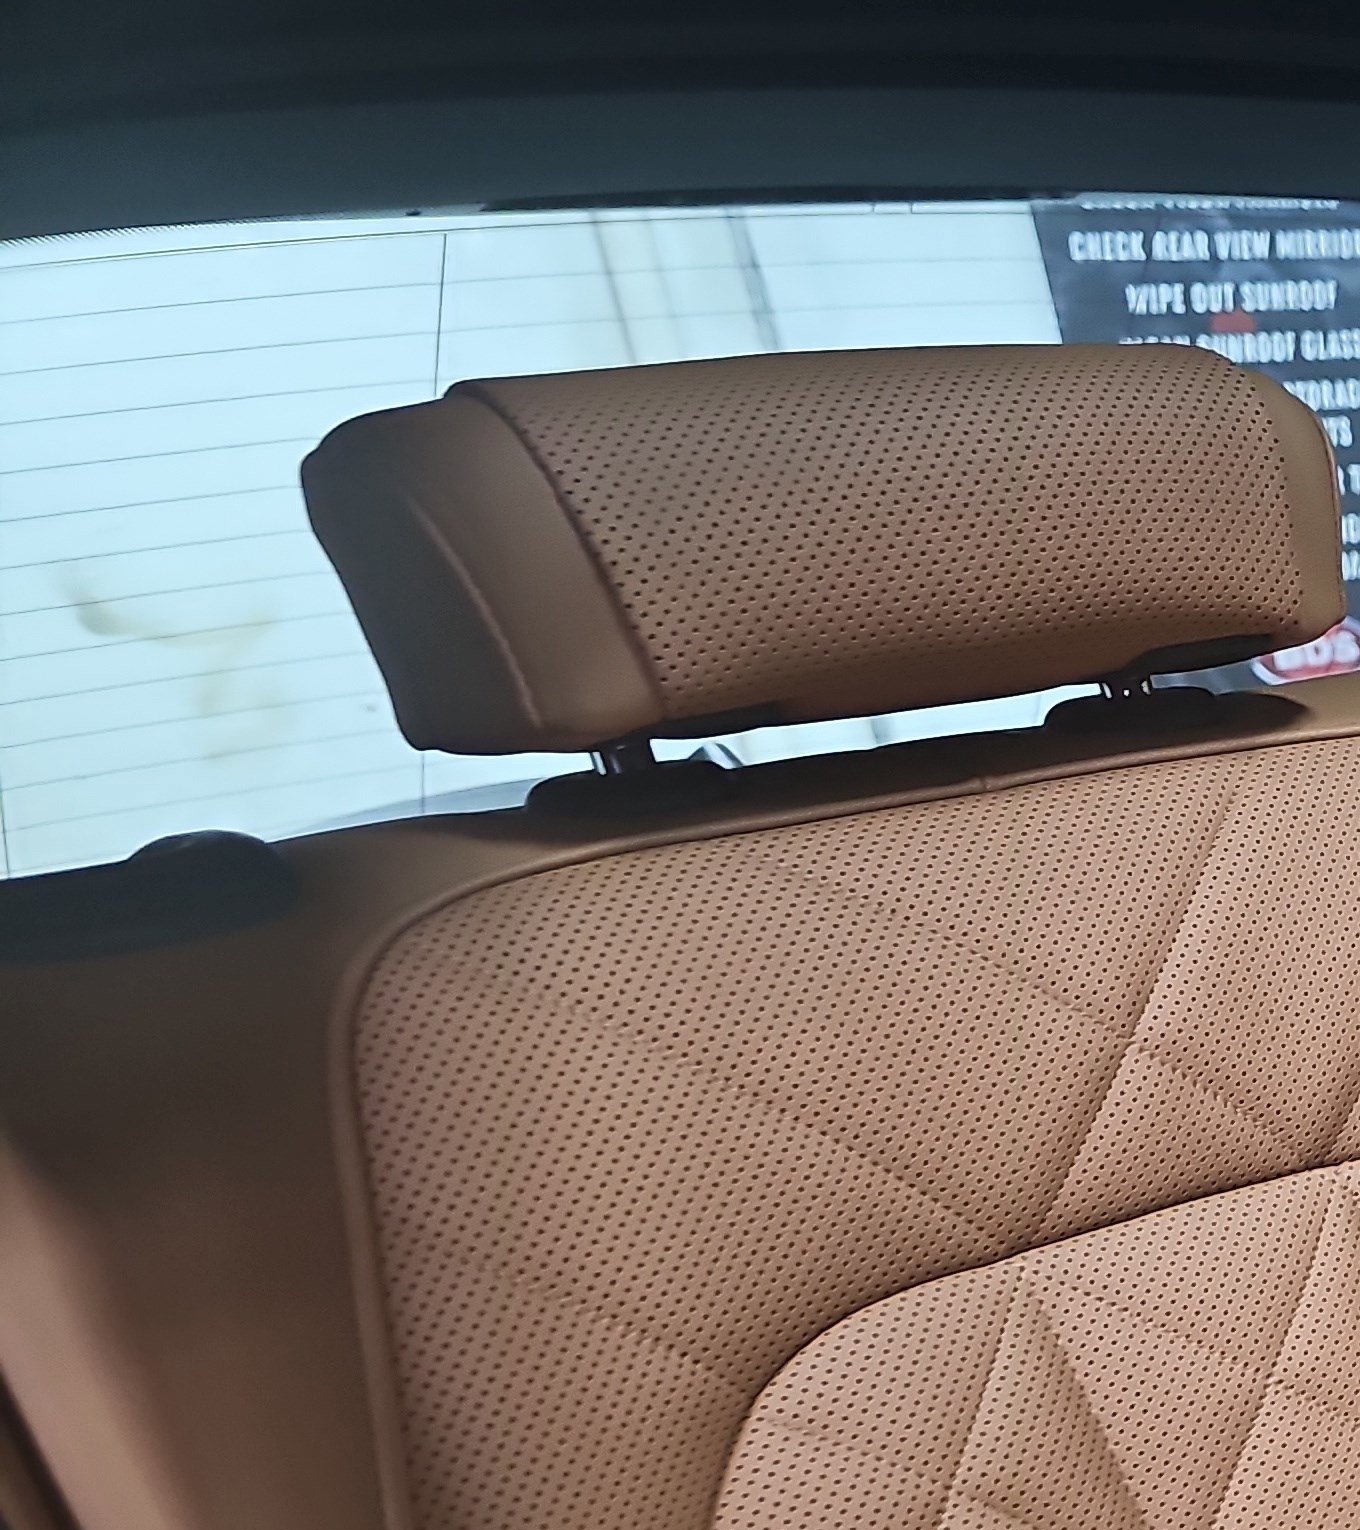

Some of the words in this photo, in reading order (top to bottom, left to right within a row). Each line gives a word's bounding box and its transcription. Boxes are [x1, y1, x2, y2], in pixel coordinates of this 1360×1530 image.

[1068, 229, 1147, 262] CHECK
[1151, 229, 1211, 262] REAR
[1213, 228, 1271, 261] VIEW
[1125, 282, 1187, 316] WIPE
[1190, 280, 1236, 314] OUT
[1239, 278, 1338, 313] SUNROOF
